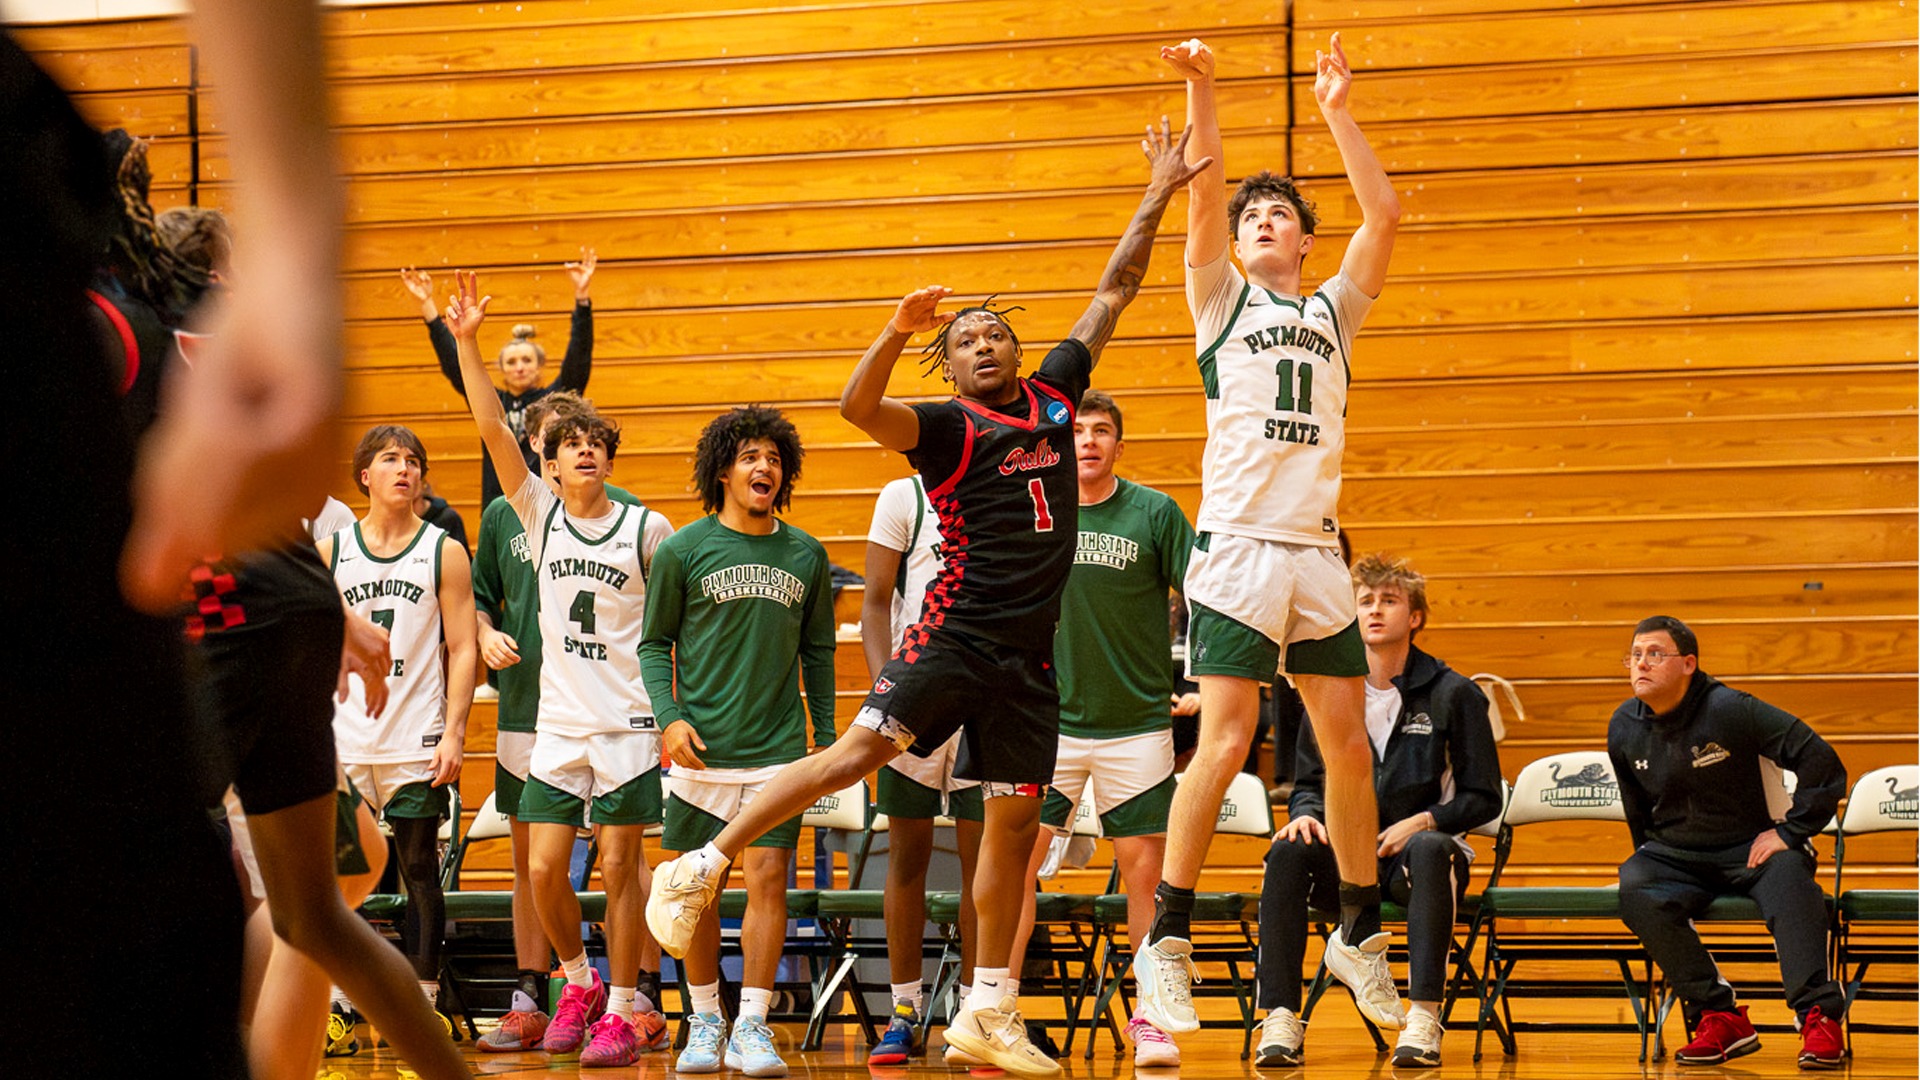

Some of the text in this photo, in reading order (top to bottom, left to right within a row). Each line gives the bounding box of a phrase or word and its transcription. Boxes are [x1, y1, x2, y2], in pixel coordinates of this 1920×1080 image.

[1243, 325, 1336, 364] PLYMOUTH
[1275, 358, 1313, 415] 11
[1264, 418, 1320, 446] STATE
[1028, 477, 1054, 533] 1
[1099, 532, 1139, 563] STATE
[549, 557, 630, 591] PLYMOUTH
[701, 563, 806, 604] PLYMOUTH STATE
[343, 579, 425, 607] PLYMOUTH
[716, 585, 792, 606] BASKETBALL
[568, 589, 596, 635] 4
[563, 634, 608, 661] STATE
[1540, 787, 1592, 803] PLYMOUTH
[1550, 799, 1613, 808] UNIVERSITY
[1879, 800, 1919, 815] PLYMOU
